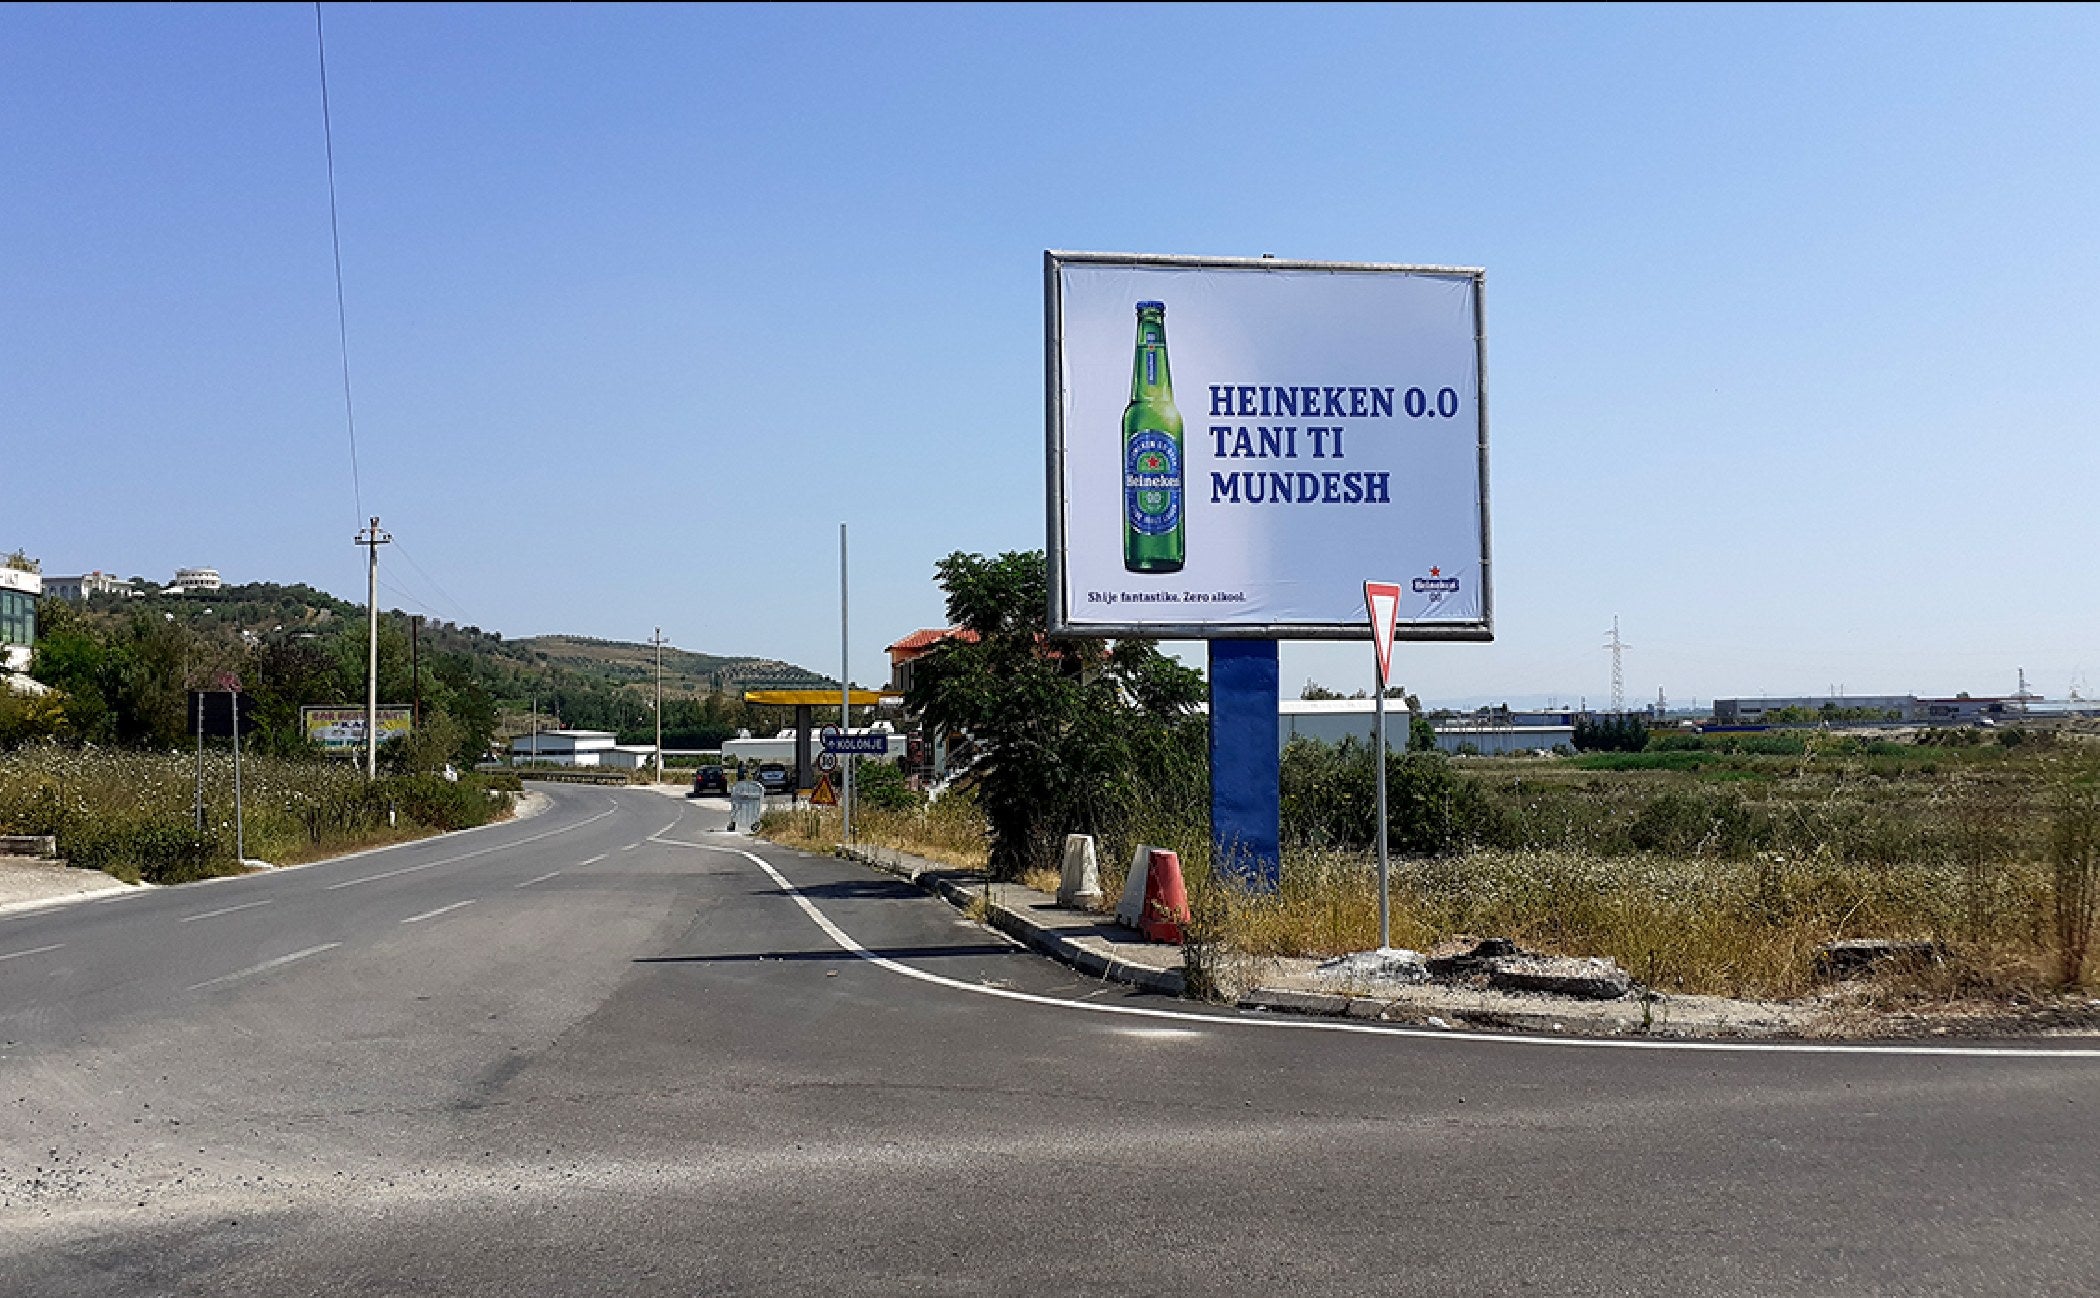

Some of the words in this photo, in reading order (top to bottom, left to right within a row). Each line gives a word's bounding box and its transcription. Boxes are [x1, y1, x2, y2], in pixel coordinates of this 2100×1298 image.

[1208, 385, 1395, 418] HEINEKEN
[1404, 386, 1459, 419] 0.0
[1209, 426, 1298, 458] TANI
[1306, 426, 1345, 458] TI
[1210, 471, 1391, 504] MUNDESH
[1087, 591, 1117, 604] Shije
[1183, 591, 1210, 602] Zero
